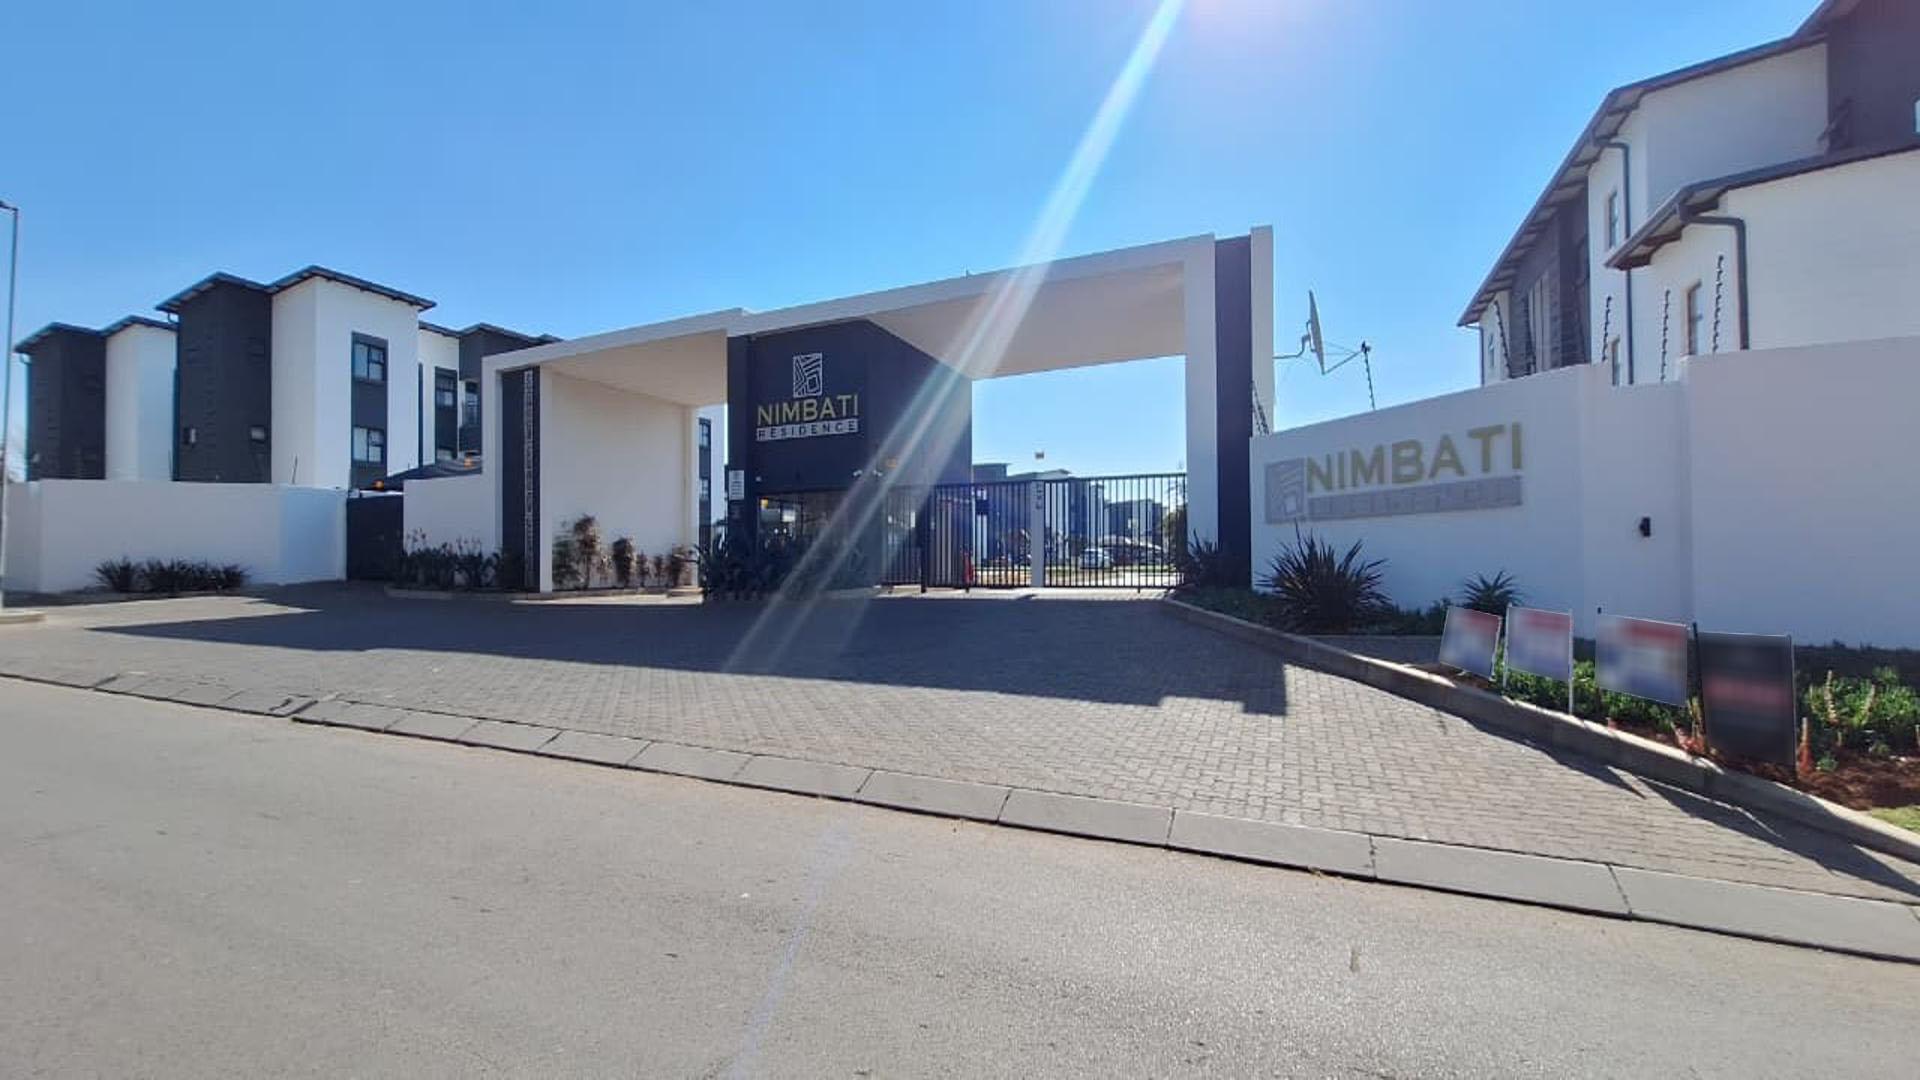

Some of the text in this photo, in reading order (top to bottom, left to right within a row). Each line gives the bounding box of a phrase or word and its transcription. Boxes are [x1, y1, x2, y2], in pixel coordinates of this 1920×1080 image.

[757, 394, 859, 426] NIMBATI
[758, 420, 857, 440] RESIDENCE
[1306, 422, 1523, 493] NIMBATI
